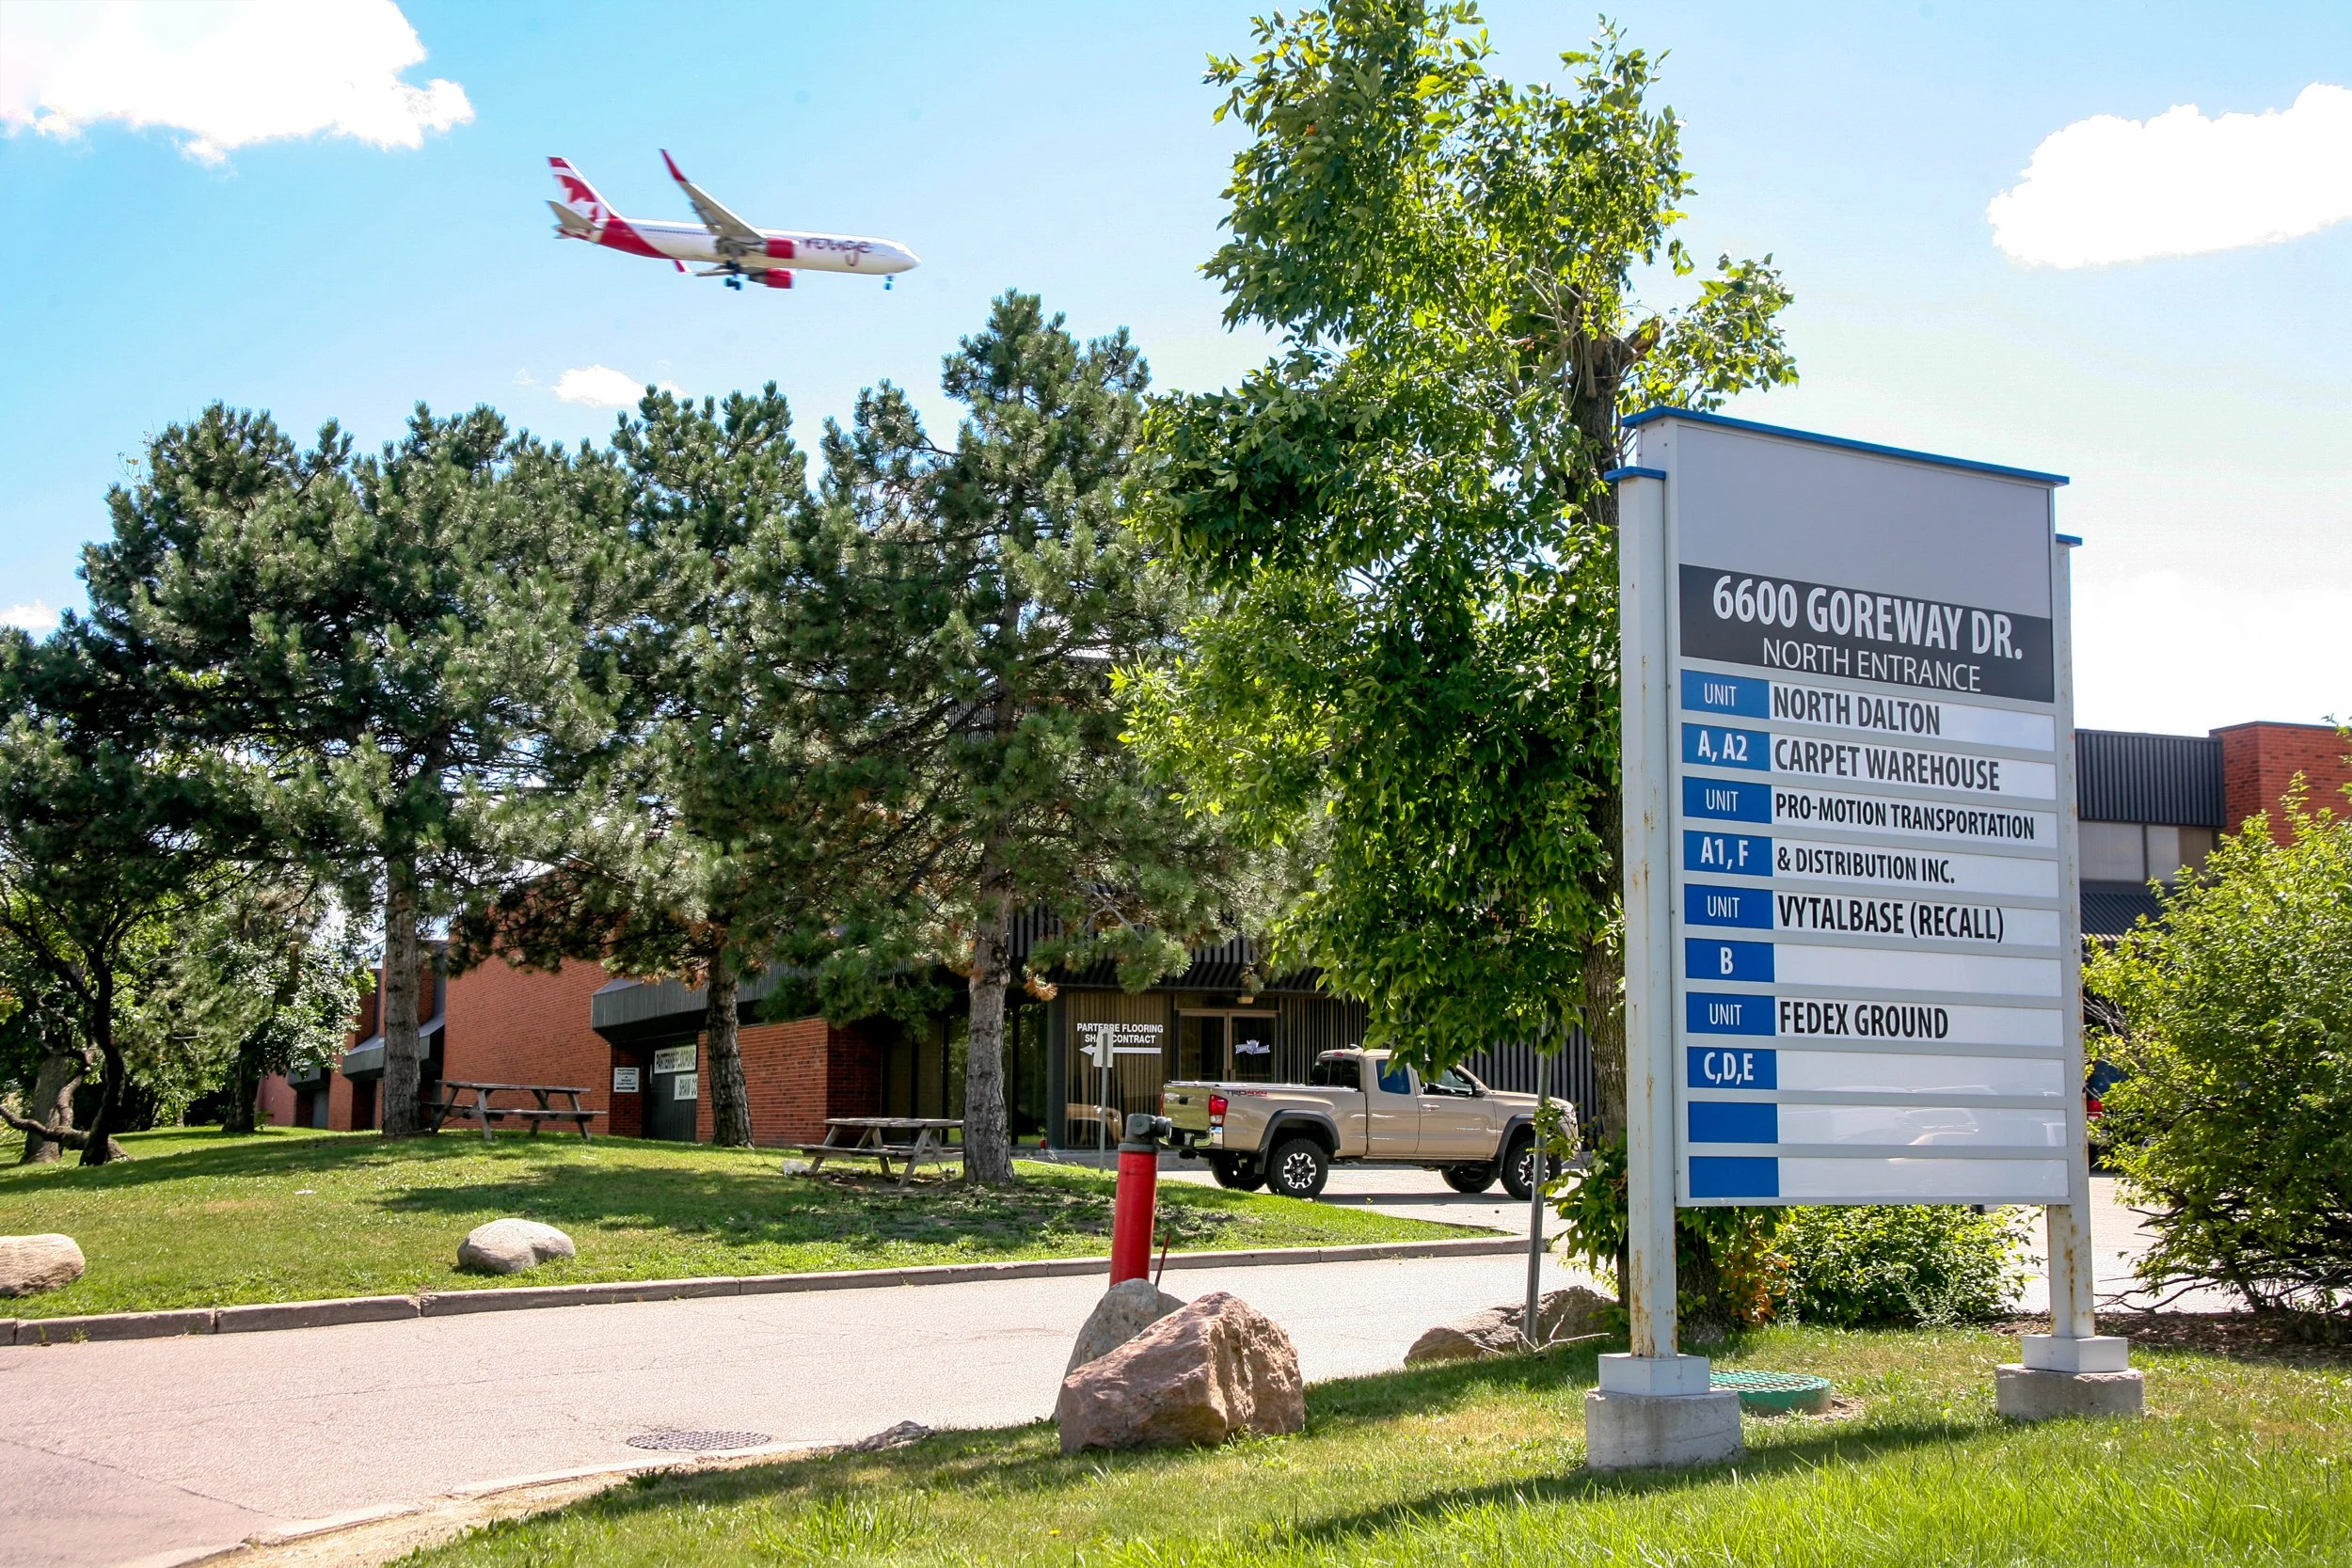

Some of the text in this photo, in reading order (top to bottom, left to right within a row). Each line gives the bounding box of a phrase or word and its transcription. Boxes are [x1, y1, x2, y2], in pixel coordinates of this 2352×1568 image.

[1713, 575, 2023, 660] 6600 GOREWAY DR.
[1763, 637, 1981, 692] NORTH ENTRANCE
[1704, 683, 1737, 707] UNIT
[1772, 685, 1941, 736] NORTH DALTON
[1723, 733, 1748, 762] A2
[1774, 738, 2000, 792] CARPET WAREHOUSE
[1706, 788, 1739, 813] UNIT
[1775, 794, 2035, 840] PRO-MOTION TRANSPORTATION
[1738, 840, 1749, 866] F
[1776, 847, 1955, 885] & DISTRIBUTION INC.
[1707, 895, 1740, 919] UNIT
[1777, 894, 2005, 943] VYTALBASE (RECALL)
[1720, 946, 1734, 975] B
[1121, 1022, 1164, 1033] FLOORING
[1708, 1002, 1742, 1026] UNIT
[1779, 1000, 1949, 1039] FEDEX GROUND
[1113, 1034, 1156, 1044] CONTRACT
